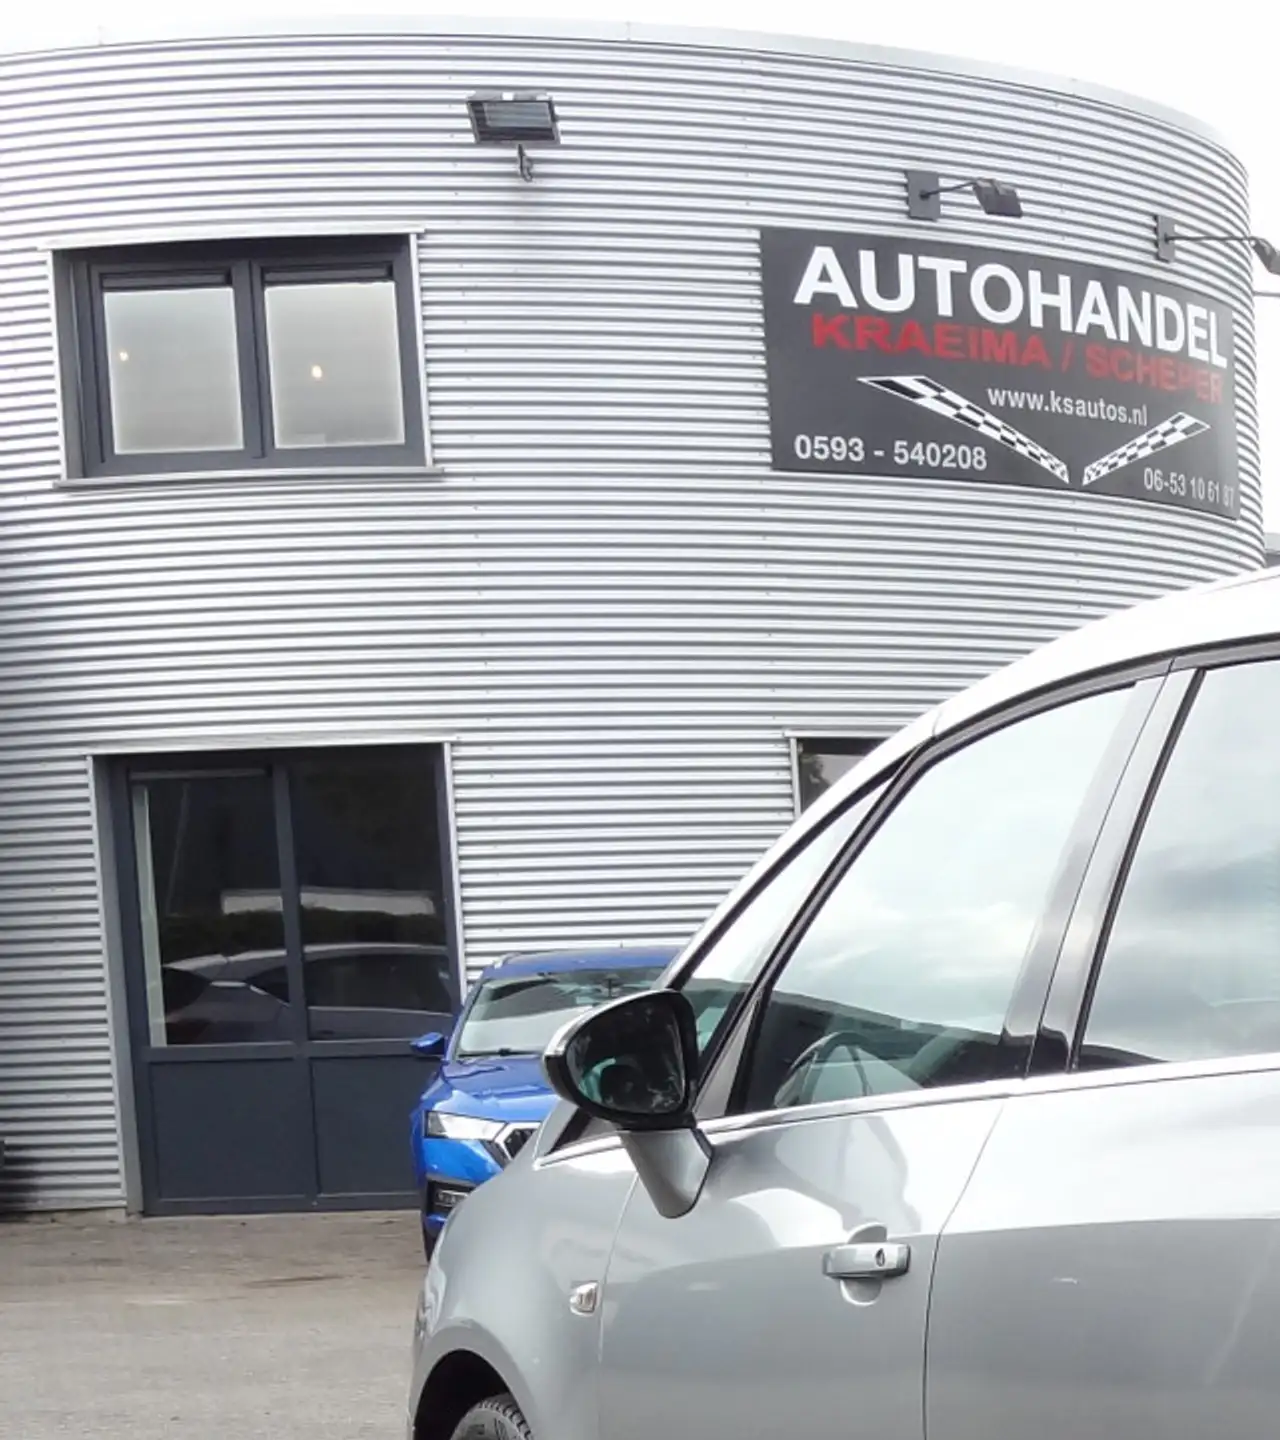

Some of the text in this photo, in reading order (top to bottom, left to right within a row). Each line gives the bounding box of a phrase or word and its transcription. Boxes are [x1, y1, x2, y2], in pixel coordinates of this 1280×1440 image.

[793, 245, 1228, 369] AUTOHANDEL
[811, 312, 1050, 368] KRAEIMA
[1085, 346, 1223, 404] SCHEPER
[986, 386, 1148, 427] www.ksautos.nl
[794, 435, 866, 463] 0593
[893, 442, 988, 472] 540208
[1143, 467, 1186, 497] 06-53
